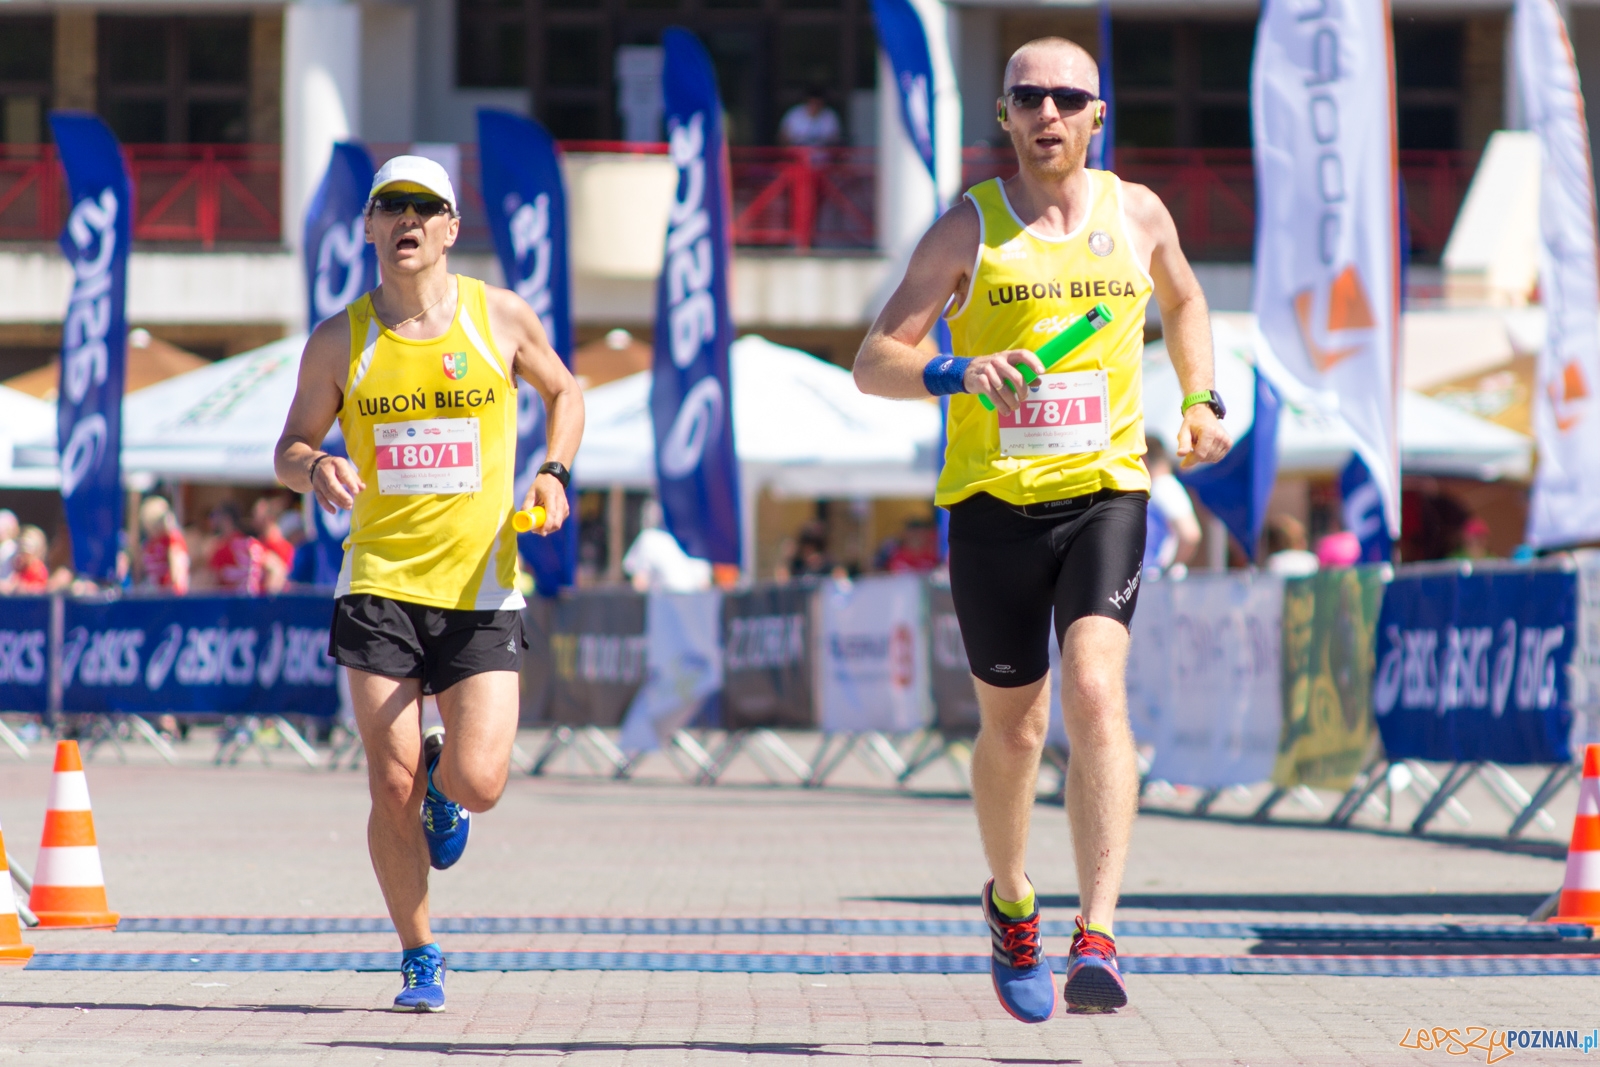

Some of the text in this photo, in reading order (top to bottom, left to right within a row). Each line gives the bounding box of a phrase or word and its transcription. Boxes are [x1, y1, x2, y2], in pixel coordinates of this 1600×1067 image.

[988, 278, 1137, 307] LUBOŃ BIEGA
[358, 387, 495, 416] LUBOŃ BIEGA
[1012, 397, 1088, 427] 178/1
[388, 443, 459, 468] 180/1
